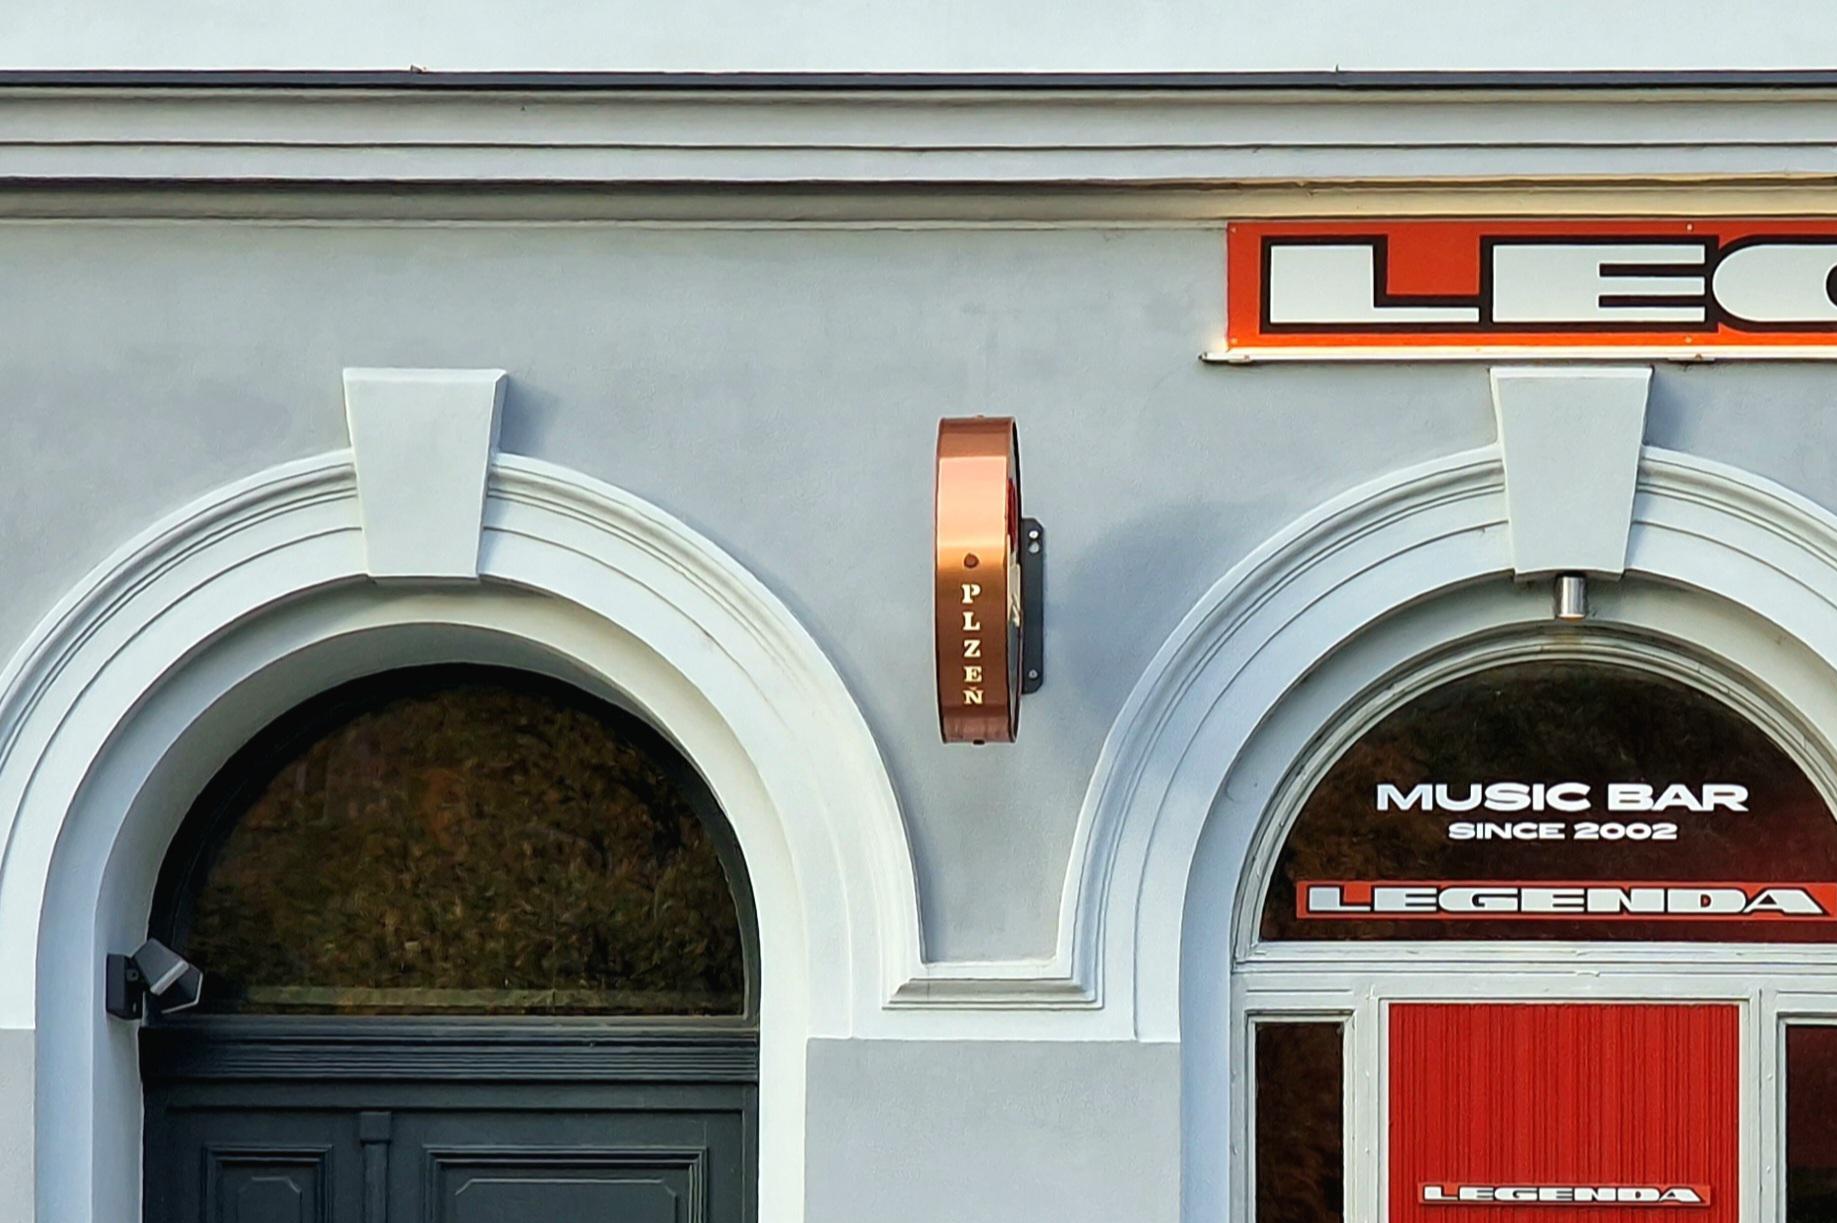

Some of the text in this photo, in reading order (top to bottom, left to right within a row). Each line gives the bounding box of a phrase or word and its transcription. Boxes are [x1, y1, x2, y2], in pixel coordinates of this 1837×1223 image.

[1377, 782, 1749, 812] MUSIC BAR
[1448, 822, 1678, 840] SINCE 2002
[1306, 885, 1826, 916] LEGENDA
[1422, 1184, 1706, 1203] LEGENDA
